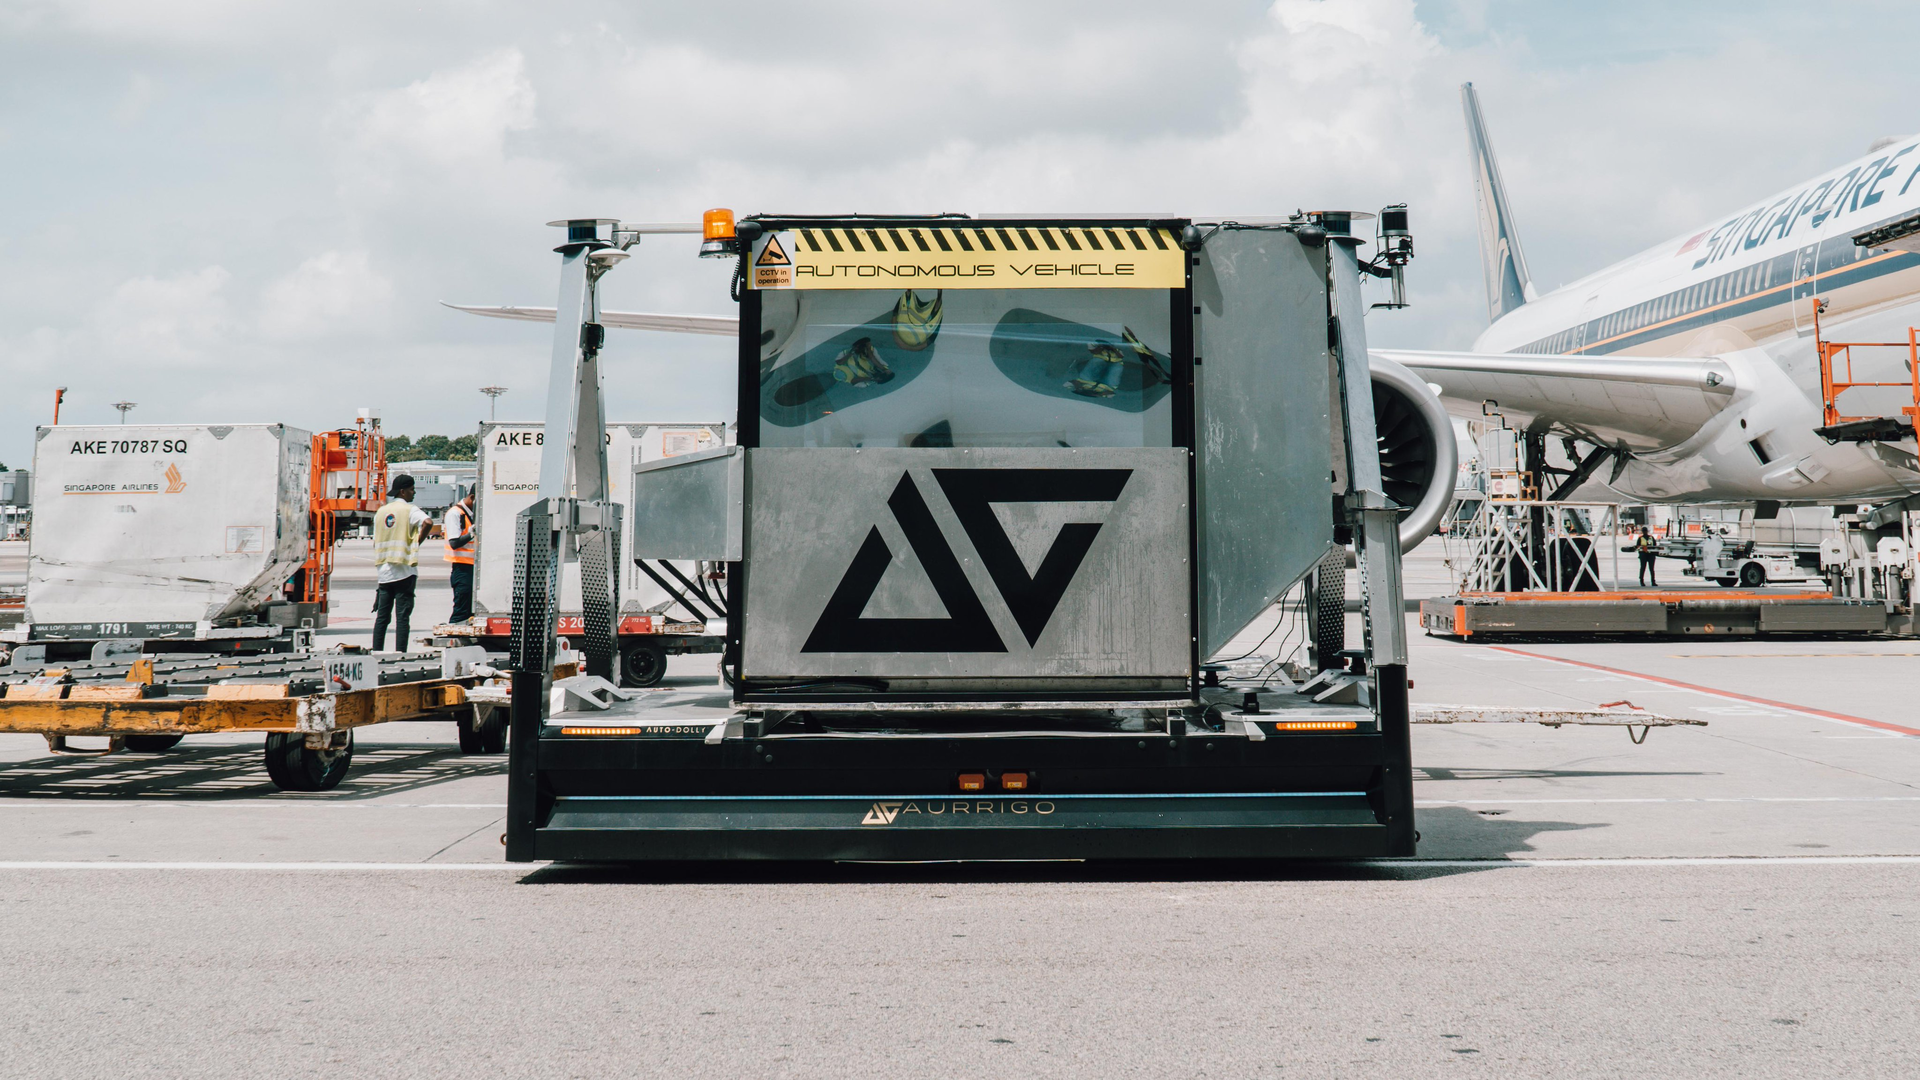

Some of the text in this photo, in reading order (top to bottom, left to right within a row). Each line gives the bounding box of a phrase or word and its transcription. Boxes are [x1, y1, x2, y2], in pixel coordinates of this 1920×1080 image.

[1691, 143, 1920, 271] SINGAPORE
[796, 264, 1135, 277] AUTONOMOUS VEHICLE
[497, 432, 532, 446] AKE
[70, 440, 187, 454] AKE 70787 SQ
[100, 624, 127, 634] 1791
[329, 663, 350, 682] 1554
[902, 802, 1055, 814] AURRIGO
